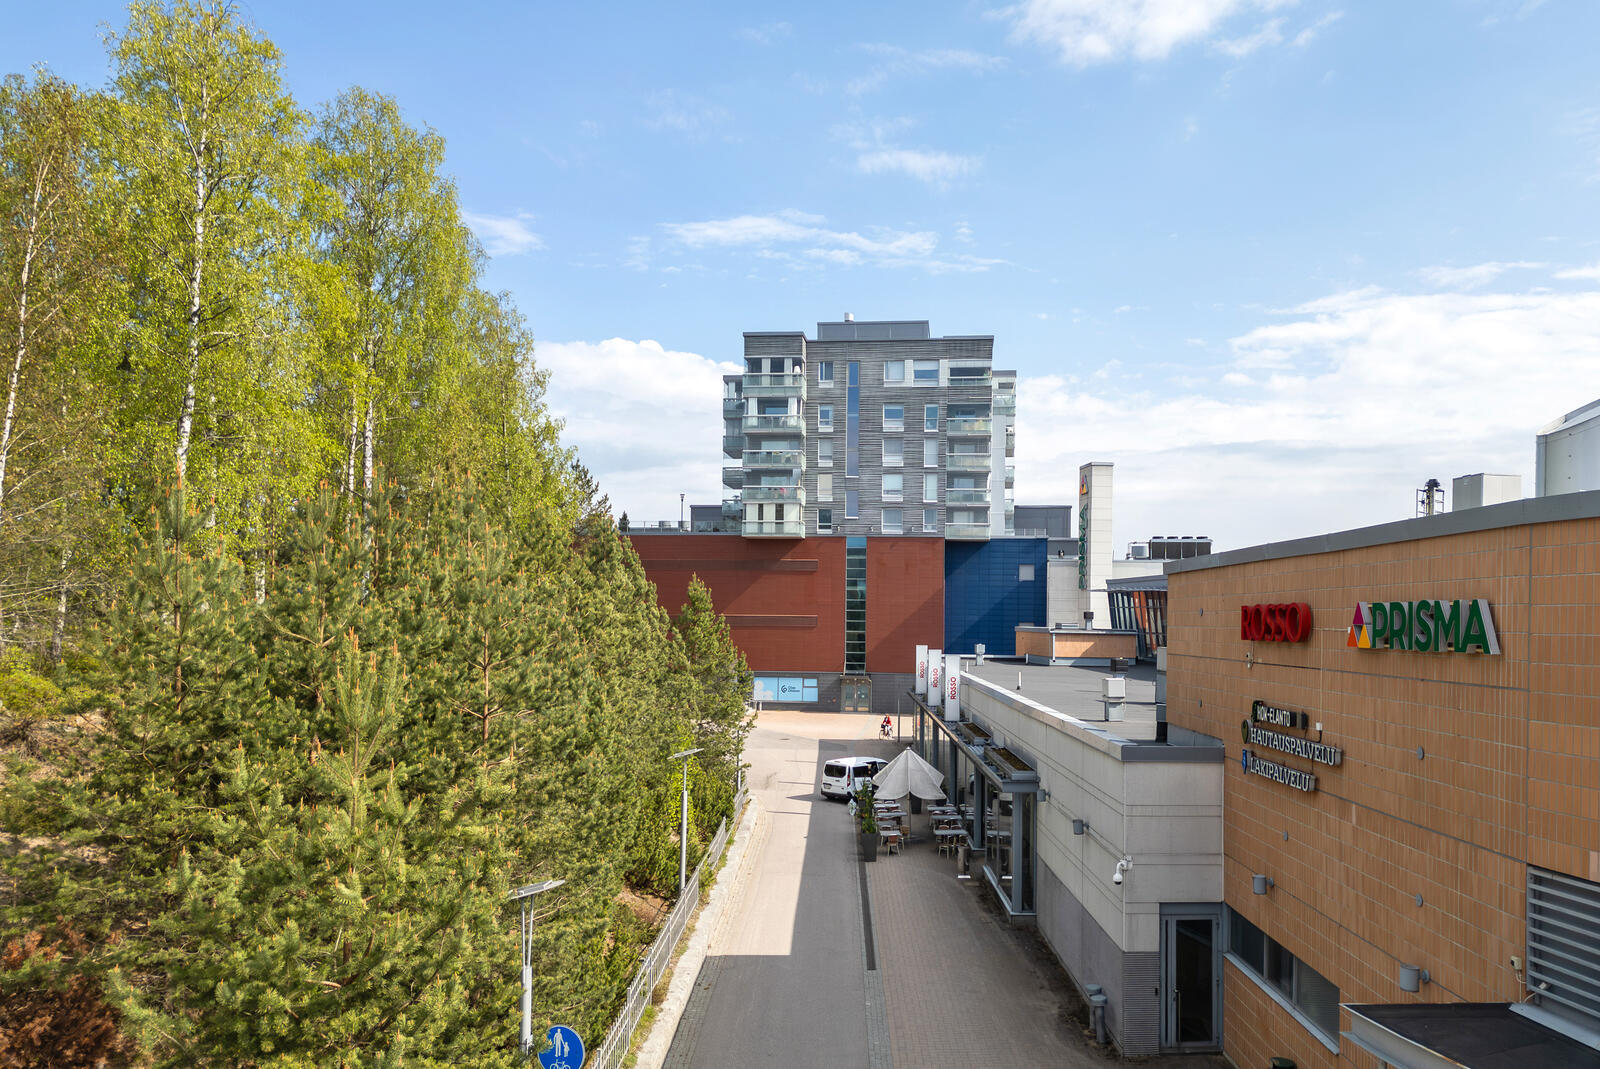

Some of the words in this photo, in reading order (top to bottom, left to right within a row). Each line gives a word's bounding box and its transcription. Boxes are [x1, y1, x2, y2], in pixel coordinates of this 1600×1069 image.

[1079, 503, 1087, 590] PRISMA
[1241, 602, 1311, 643] ROSSO
[1371, 600, 1497, 654] PRISMA
[1256, 704, 1291, 727] HOK-ELANTO
[1250, 727, 1336, 766] HAUTAUSPALVELU
[1250, 757, 1310, 792] LAKIPALVELU
